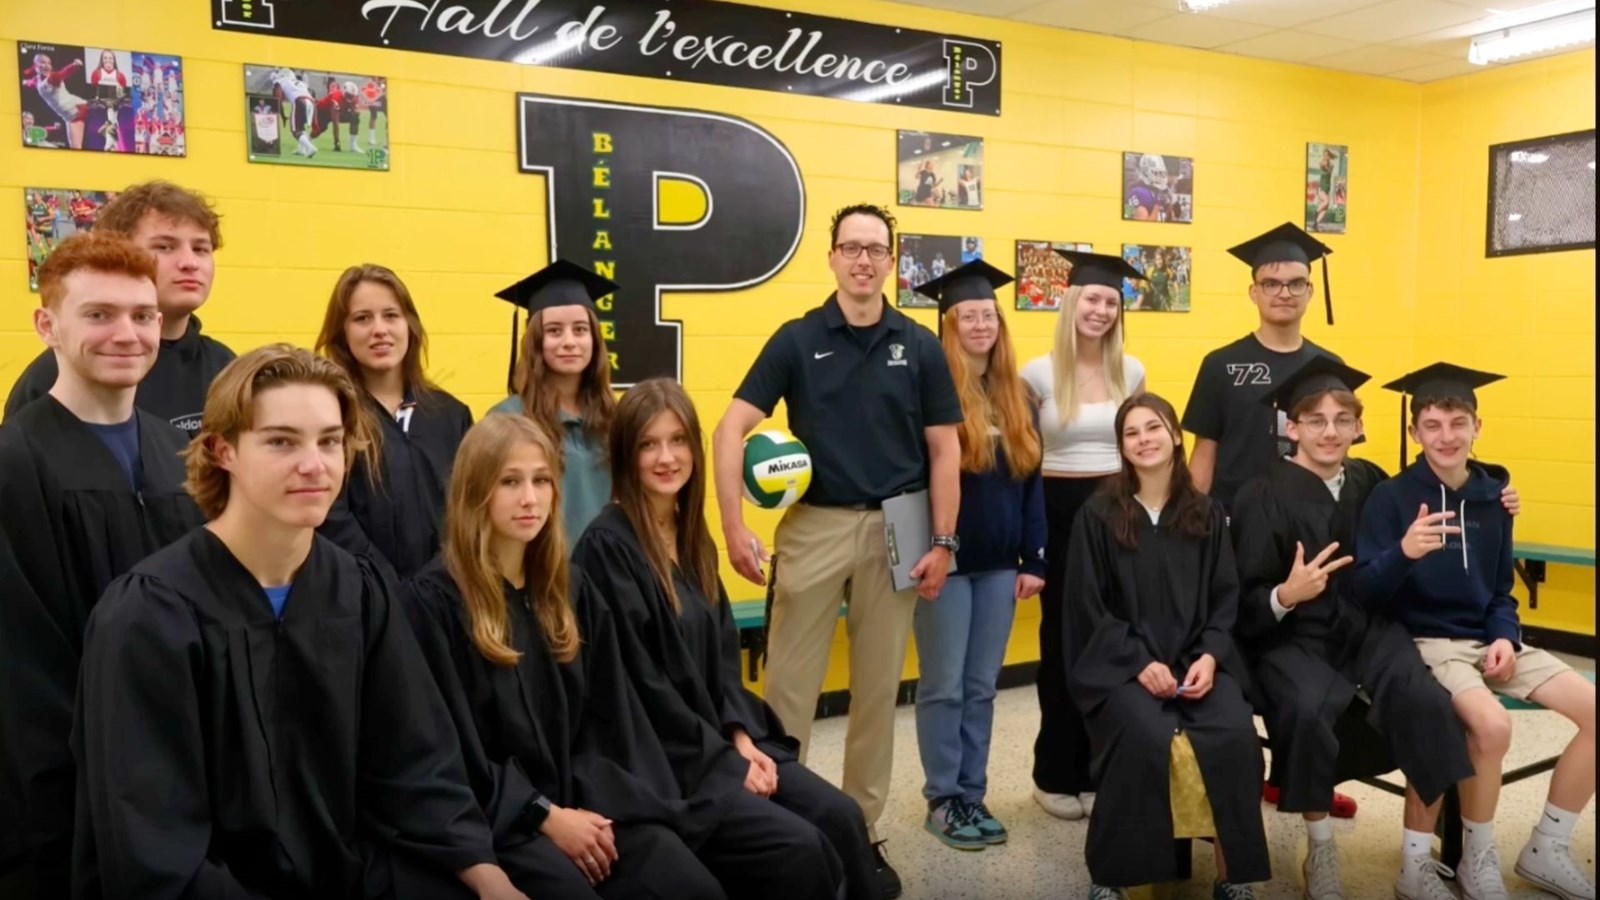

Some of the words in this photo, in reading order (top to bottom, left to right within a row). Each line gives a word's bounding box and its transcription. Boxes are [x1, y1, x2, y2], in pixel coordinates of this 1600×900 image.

[361, 0, 540, 41] Hall
[556, 6, 622, 55] de
[638, 9, 912, 86] l'excellence
[1226, 362, 1272, 387] '72
